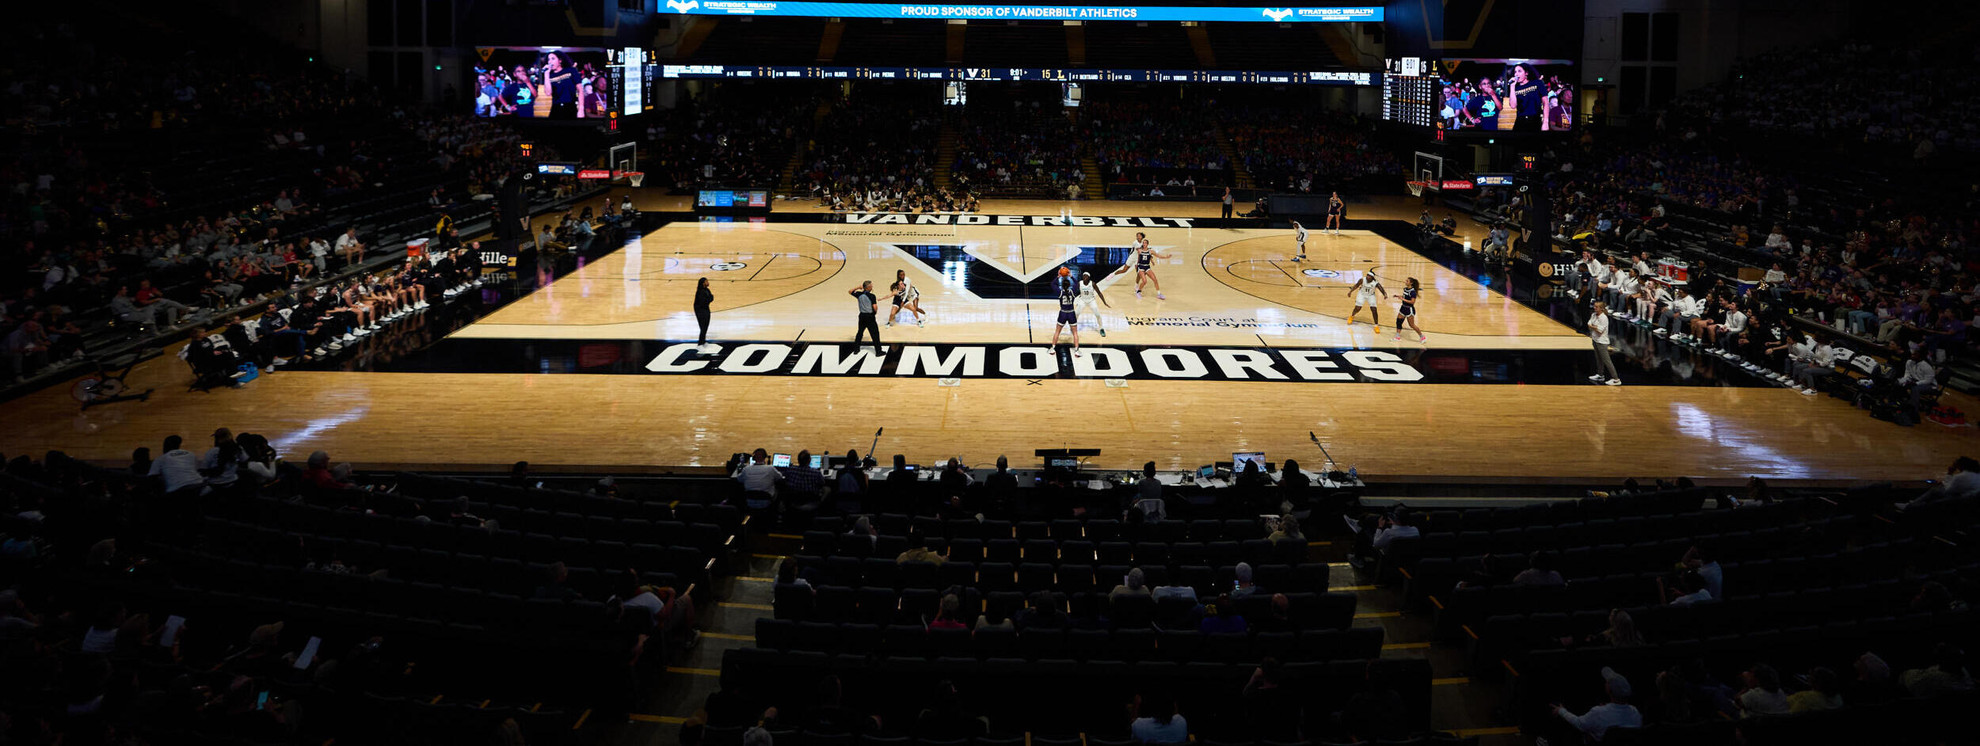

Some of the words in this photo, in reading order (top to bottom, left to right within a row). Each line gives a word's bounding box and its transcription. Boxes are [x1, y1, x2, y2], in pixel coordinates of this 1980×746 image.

[901, 6, 939, 16] PROUD
[942, 6, 994, 16] SPONSOR
[996, 7, 1010, 16] OF
[1012, 8, 1077, 17] VANDERBILT
[1080, 8, 1137, 18] ATHLETICS
[606, 49, 614, 62] V
[1385, 58, 1392, 69] V
[1432, 60, 1437, 71] L
[966, 68, 979, 78] V
[981, 68, 990, 78] 31
[1042, 69, 1050, 78] 15
[1057, 70, 1064, 79] L
[520, 216, 530, 231] V
[846, 212, 1194, 228] VANDERBILT
[1521, 227, 1532, 243] V
[645, 343, 1424, 381] COMMODORES
